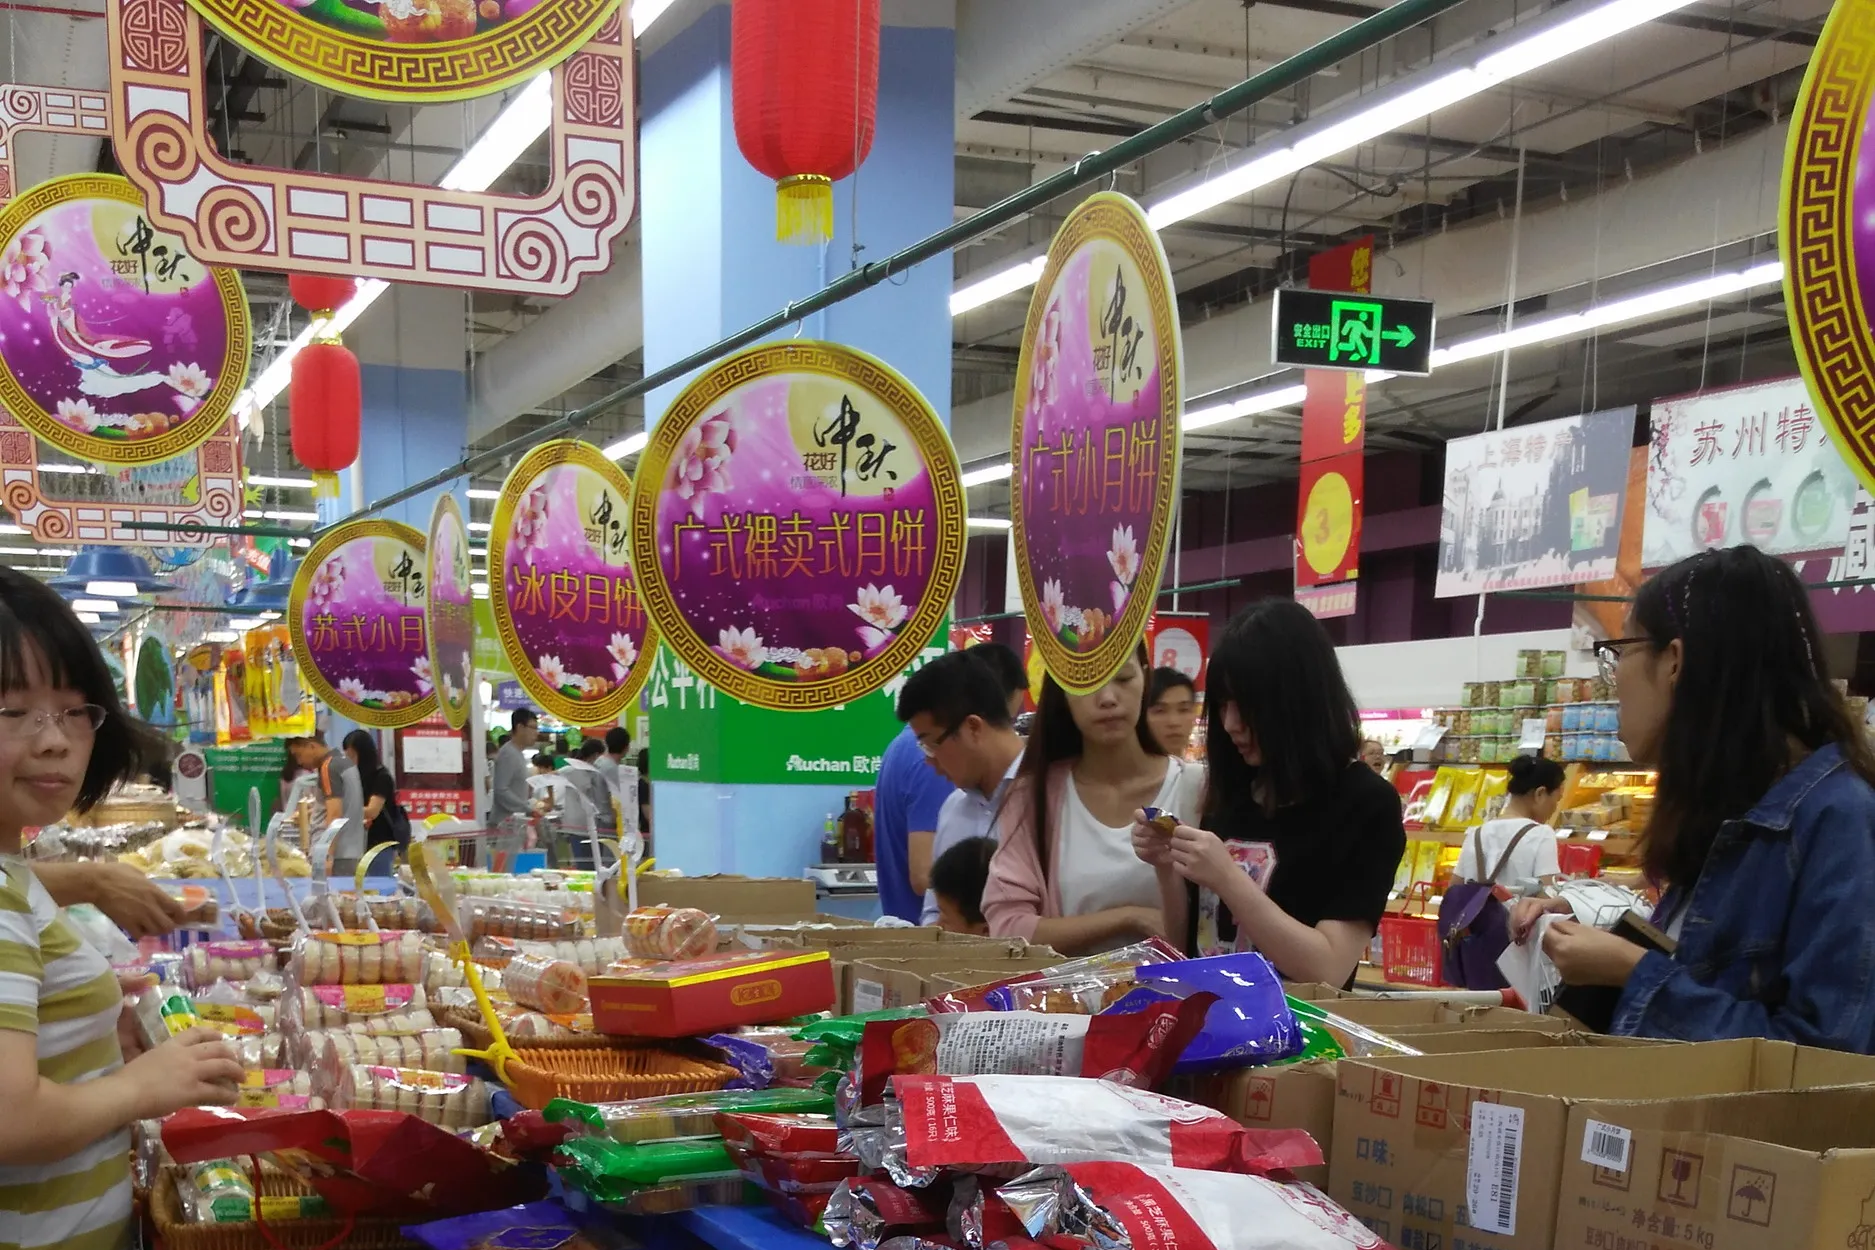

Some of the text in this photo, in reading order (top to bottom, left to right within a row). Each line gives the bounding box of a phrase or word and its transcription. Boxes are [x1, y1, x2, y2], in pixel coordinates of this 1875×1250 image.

[115, 215, 190, 296] 中秋
[1101, 264, 1144, 406] 中秋
[1294, 323, 1330, 339] 安全出口
[1296, 340, 1326, 348] EXIT
[803, 452, 837, 471] 花好
[813, 394, 898, 498] 中秋
[1026, 419, 1157, 516] 广式小月饼
[1477, 429, 1573, 470] 上海特产
[673, 509, 926, 581] 广式裸卖式月饼
[513, 564, 646, 629] 冰皮月饼
[311, 613, 424, 652] 苏式小月
[786, 755, 882, 774] Auchan 欧尚
